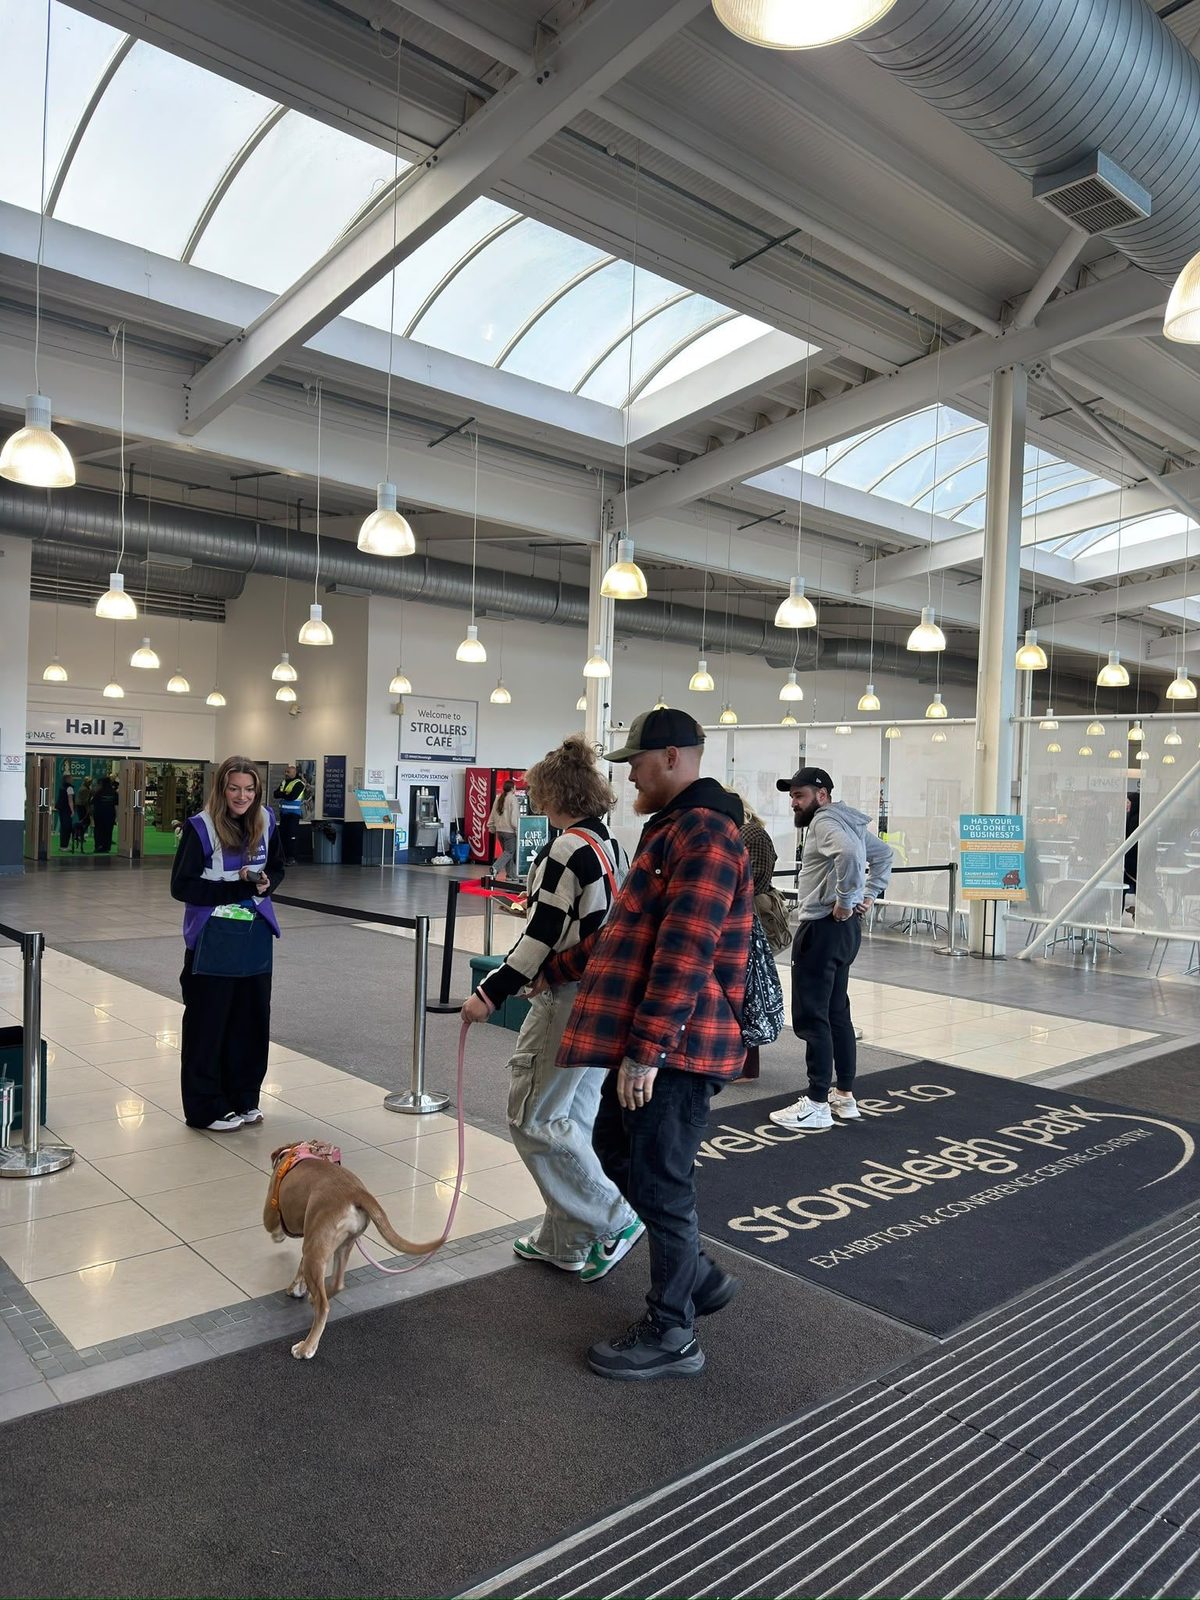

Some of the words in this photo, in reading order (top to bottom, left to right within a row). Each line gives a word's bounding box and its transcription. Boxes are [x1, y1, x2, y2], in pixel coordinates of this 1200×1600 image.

[417, 709, 452, 720] Welcome
[453, 713, 461, 721] to
[66, 718, 105, 736] Hall
[113, 721, 124, 737] 2
[410, 722, 467, 736] STROLLERS
[970, 831, 1014, 839] BUSINESS?
[887, 1084, 956, 1102] to
[727, 1136, 1019, 1243] stoneleigh
[996, 1104, 1103, 1151] park
[808, 1219, 929, 1269] EXHIBITION
[919, 1214, 946, 1225] &
[935, 1173, 1046, 1219] CONFERENCE
[1034, 1152, 1098, 1177] CENTRE
[1085, 1128, 1154, 1156] COVENTRY
